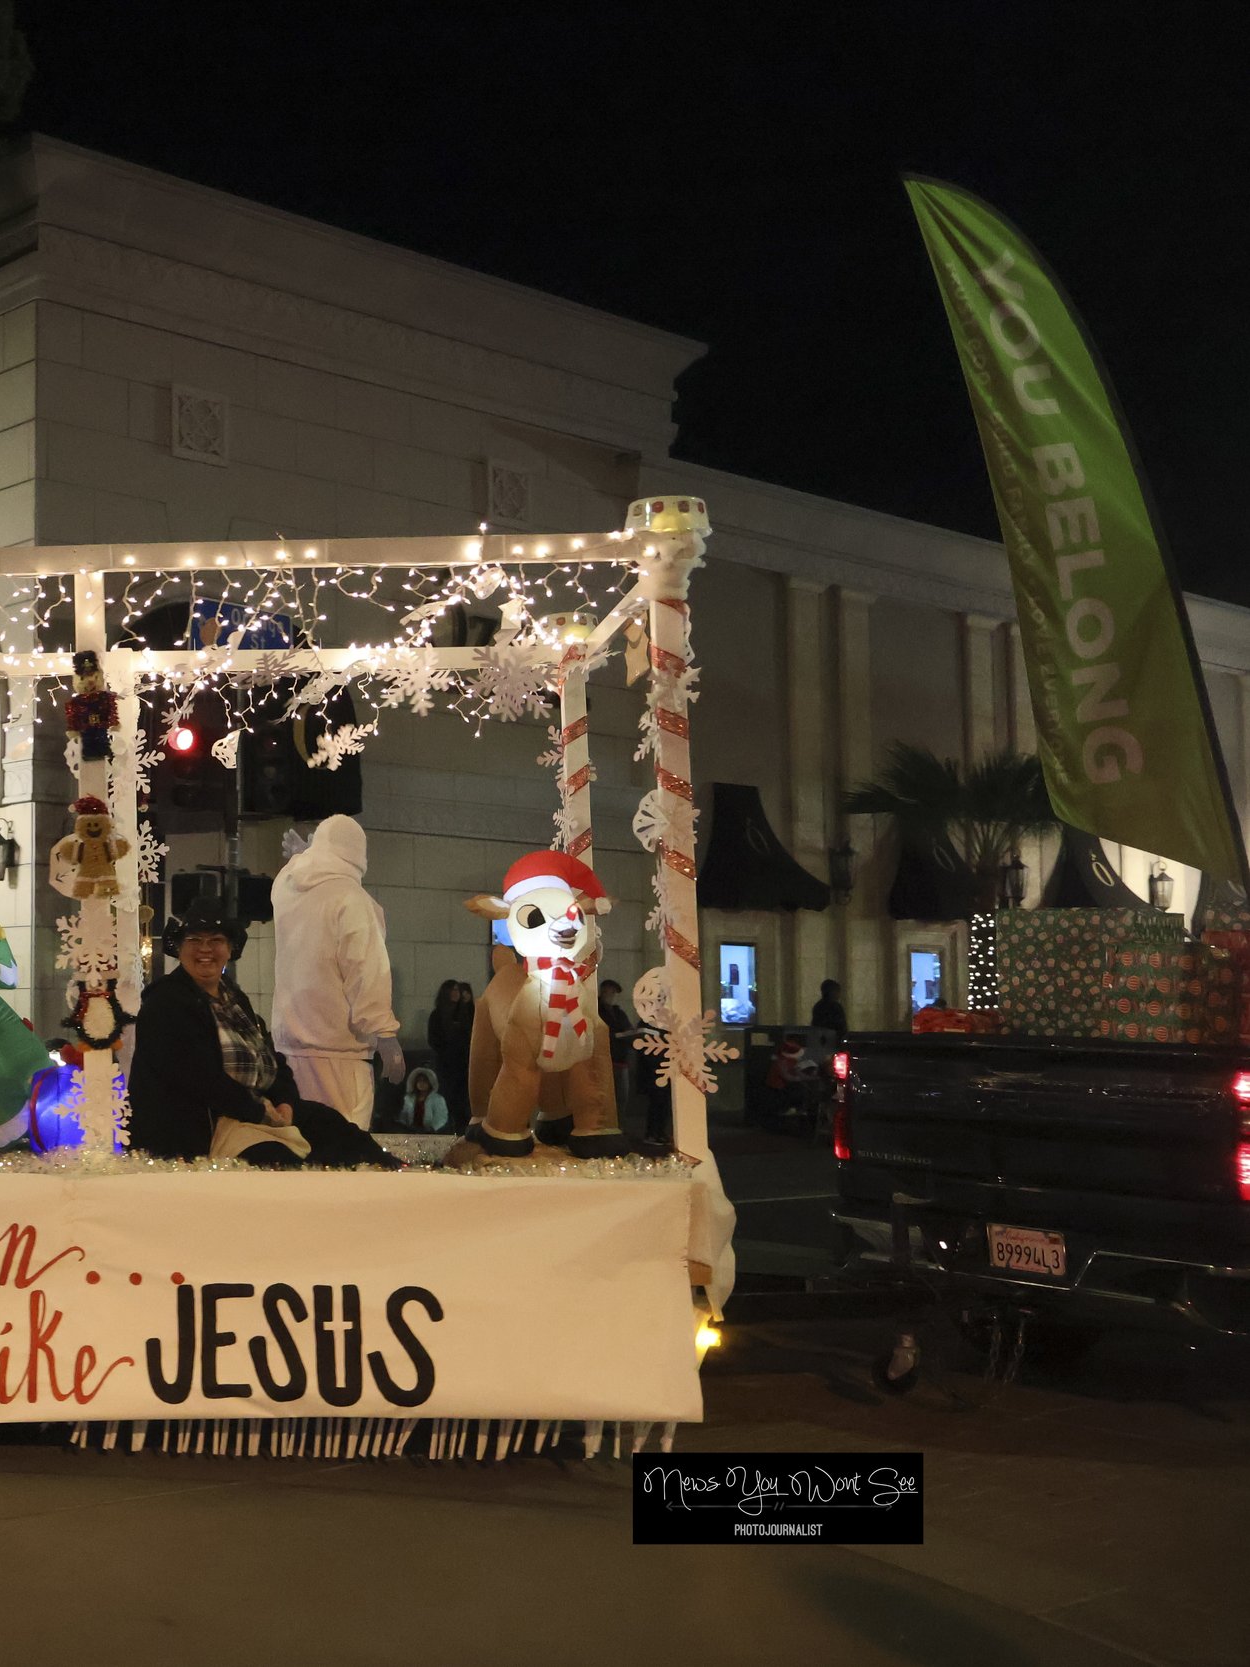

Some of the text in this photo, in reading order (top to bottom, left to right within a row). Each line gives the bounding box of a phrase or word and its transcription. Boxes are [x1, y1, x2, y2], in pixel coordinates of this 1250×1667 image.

[979, 250, 1143, 785] YOU BELONG
[996, 1242, 1061, 1270] 89994L3
[146, 1283, 445, 1407] JESUS
